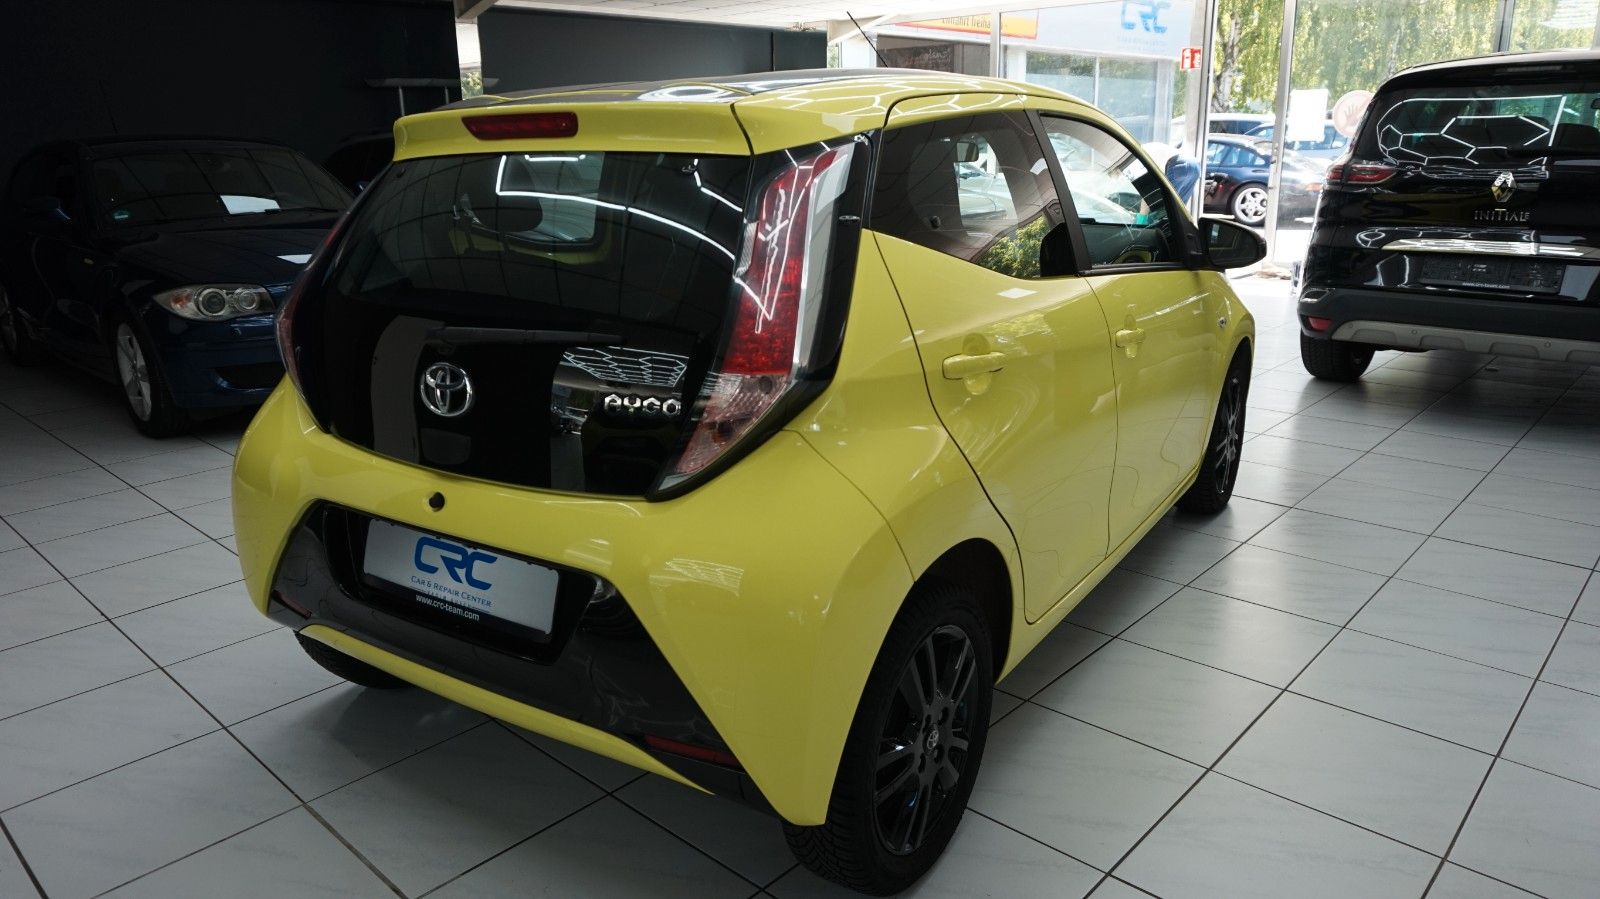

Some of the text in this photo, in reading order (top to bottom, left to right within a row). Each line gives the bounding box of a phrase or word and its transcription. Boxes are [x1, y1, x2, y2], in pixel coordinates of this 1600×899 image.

[604, 394, 681, 415] AYGO
[415, 536, 498, 591] CRC
[415, 594, 480, 621] www.crc-team.com
